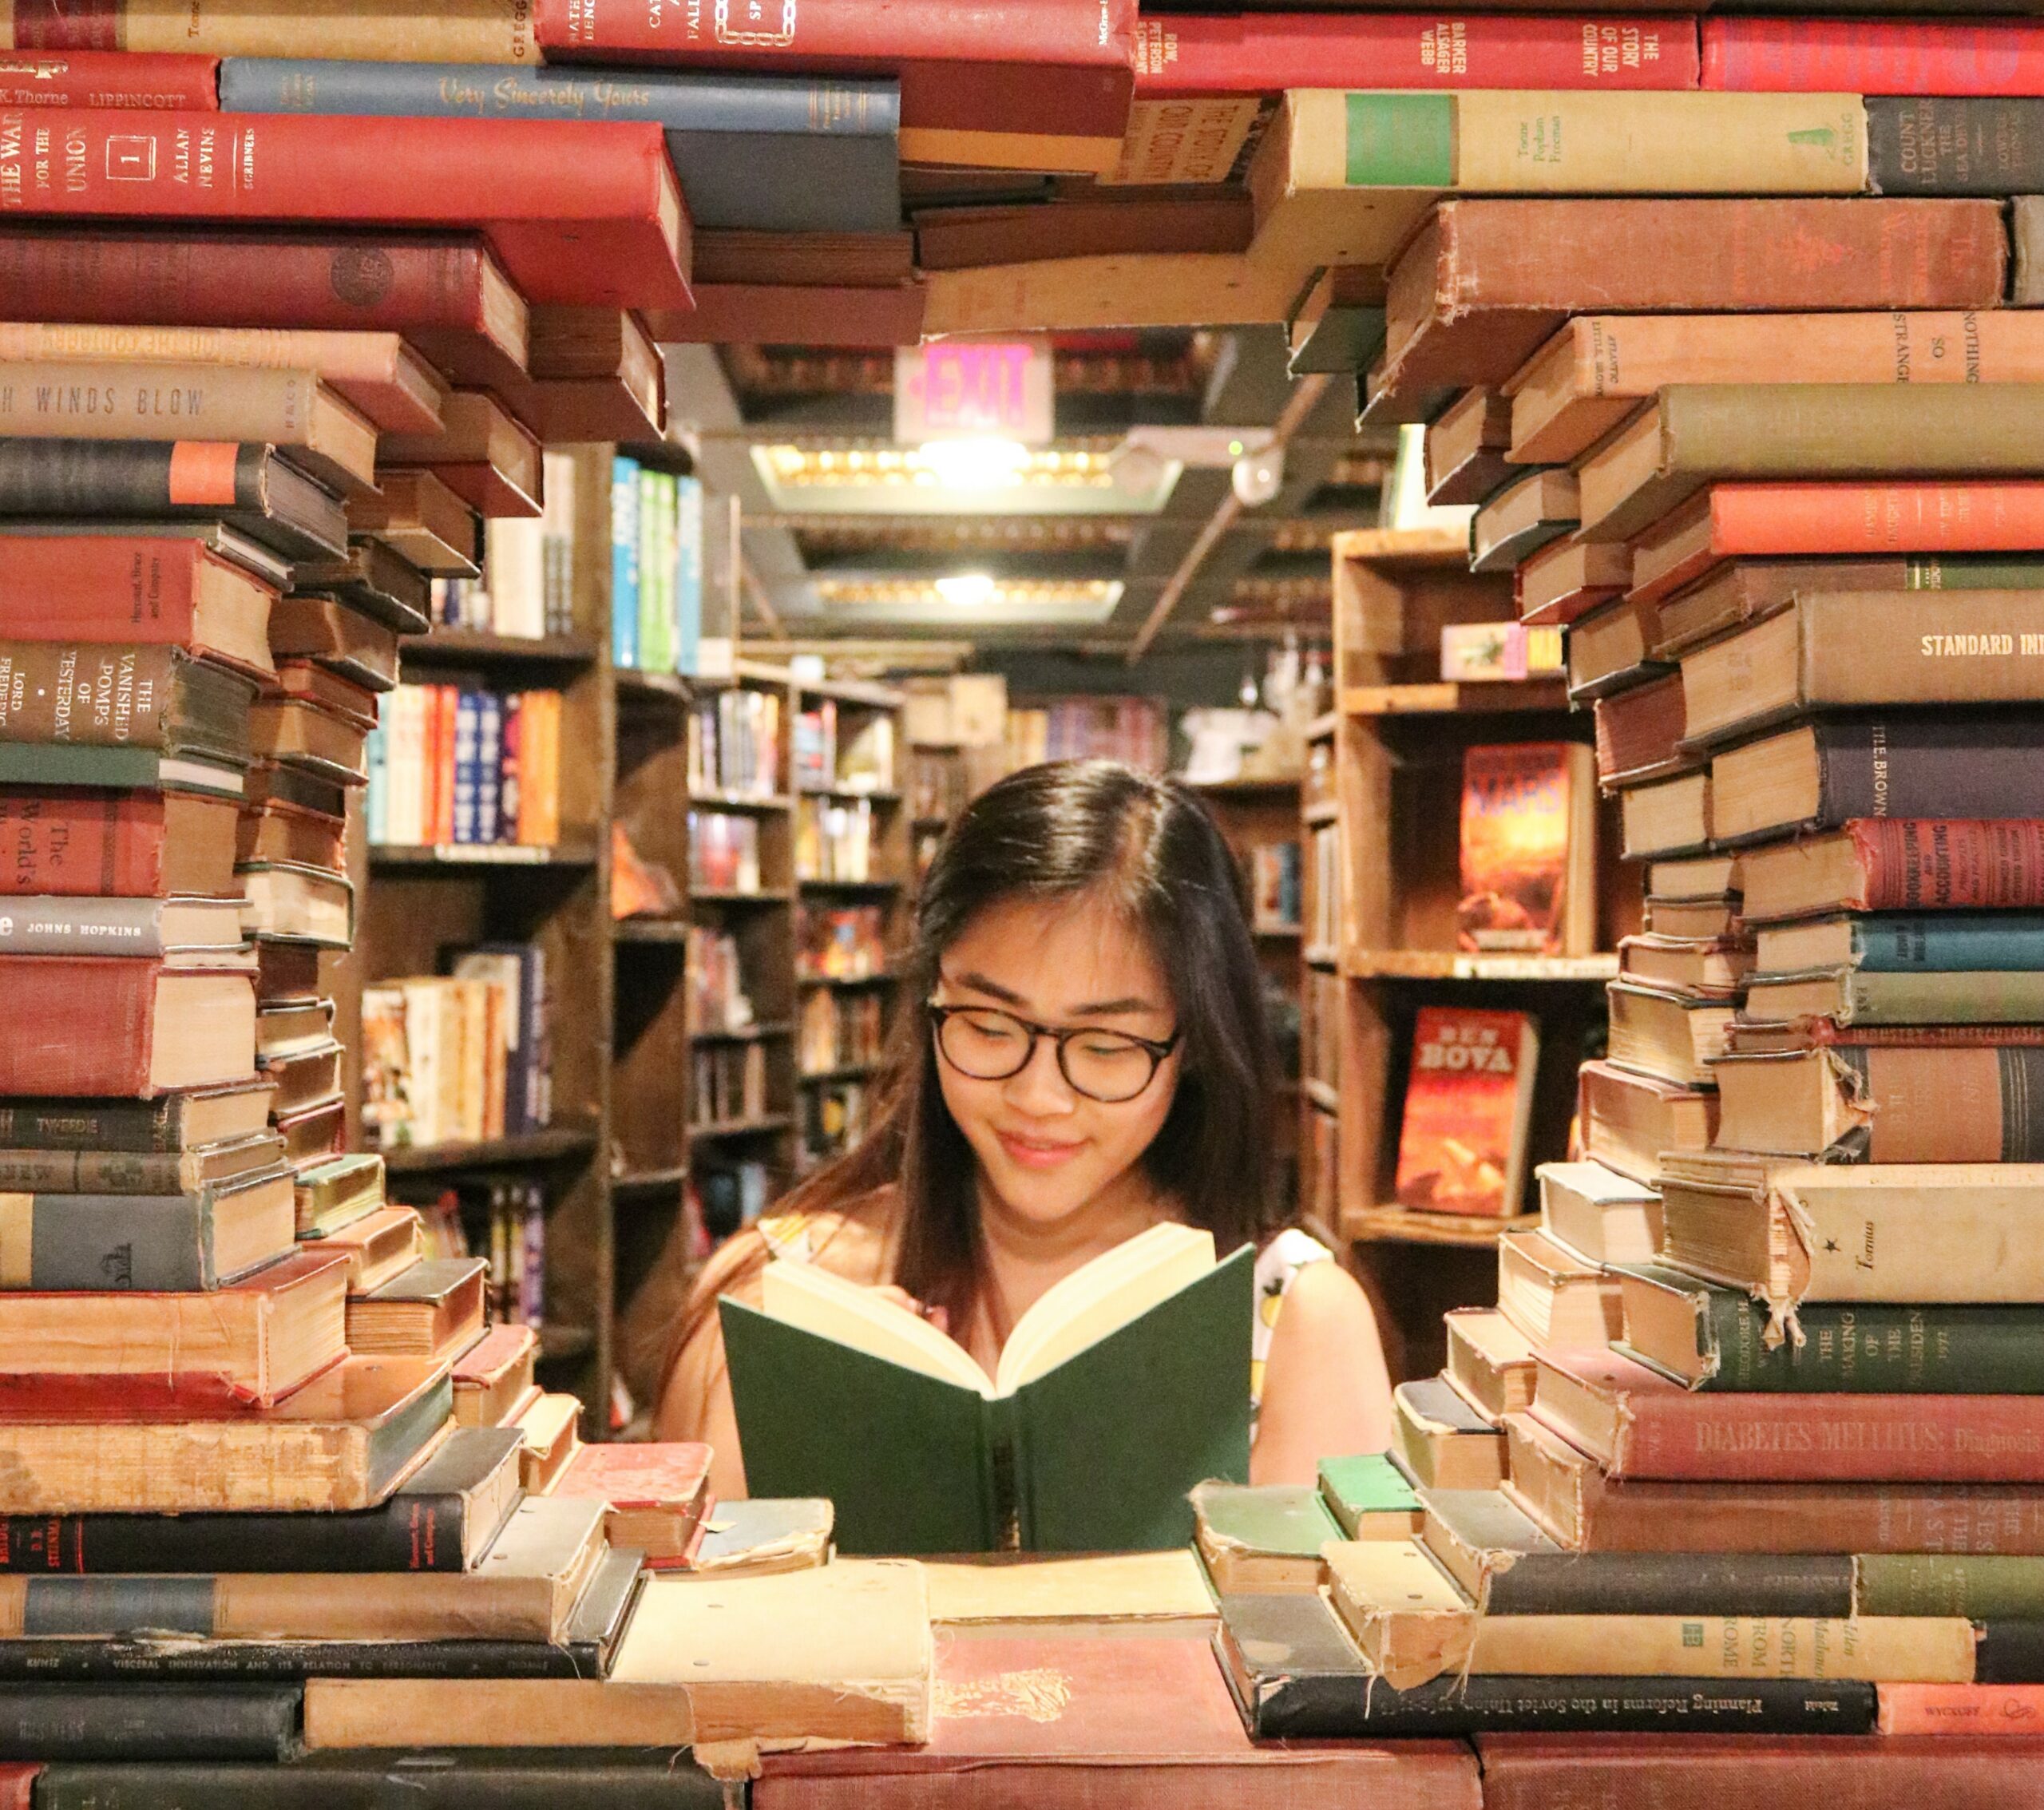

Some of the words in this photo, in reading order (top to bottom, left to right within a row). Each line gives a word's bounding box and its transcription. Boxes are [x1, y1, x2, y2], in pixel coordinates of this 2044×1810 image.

[1149, 21, 1163, 74] PETERSON
[1164, 33, 1178, 64] ROW,
[1420, 30, 1436, 65] WEBB
[1436, 22, 1451, 74] ALSAGER
[1451, 22, 1467, 74] BARKER
[1583, 23, 1598, 77] COUNTRY
[1601, 26, 1617, 45] OF
[1622, 27, 1639, 68] STORY
[1643, 34, 1660, 61] THE
[1602, 46, 1618, 73] OUR
[14, 88, 69, 105] Thorne
[89, 93, 187, 109] LIPPINCOTT
[439, 76, 485, 114] Very
[493, 75, 584, 117] Sincerely
[592, 77, 651, 117] Yours
[36, 128, 50, 155] THE
[65, 125, 88, 192] UNION
[173, 128, 190, 184] ALLAN
[199, 127, 215, 188] NEVINS
[1518, 121, 1529, 159] Tonne
[1841, 112, 1855, 166] GREGG
[1899, 111, 1916, 173] COUNT
[1919, 99, 1937, 184] LUCKNER
[1939, 124, 1951, 156] THE
[36, 160, 50, 189] FOR
[120, 155, 141, 164] 1
[242, 128, 256, 191] SCRIBNERS
[1956, 153, 1968, 183] SEA
[2, 162, 23, 206] THE
[1607, 335, 1618, 384] ATLANTIC
[1892, 313, 1910, 383] STRANGE
[1931, 337, 1945, 359] SO
[1963, 311, 1979, 384] NOTHING
[37, 386, 116, 414] WINDS
[137, 387, 204, 417] BLOW
[923, 343, 1035, 427] EXIT
[1920, 634, 2014, 656] STANDARD
[10, 671, 26, 711] LORD
[54, 650, 77, 742] YESTERDAY
[78, 682, 93, 705] OF
[93, 663, 114, 726] POMPS
[115, 652, 136, 742] VANISHED
[137, 679, 154, 714] THE
[1872, 760, 1888, 818] BROWN
[16, 800, 41, 886] World's
[49, 822, 70, 868] The
[1932, 824, 1951, 906] ACCOUNTING
[27, 922, 72, 935] JOHNS
[80, 924, 141, 937] HOPKINS
[1737, 1317, 1749, 1386] THEODORE
[1819, 1329, 1833, 1362] THE
[1840, 1312, 1856, 1379] MAKING
[1865, 1333, 1880, 1357] OF
[1886, 1327, 1901, 1362] THE
[1907, 1310, 1924, 1388] PRESIDEN
[1695, 1421, 1812, 1452] DIABETES
[1722, 1616, 1739, 1668] ROME
[26, 1658, 61, 1669] KUNTZ
[113, 1659, 160, 1670] VISCERAL
[168, 1660, 238, 1670] INNERVATION
[246, 1661, 269, 1670] AND
[277, 1661, 294, 1670] ITS
[302, 1661, 351, 1671] RELATION
[1464, 1697, 1515, 1716] Union
[1516, 1698, 1567, 1716] Soviet
[1570, 1697, 1597, 1715] the
[1601, 1698, 1619, 1715] in
[1622, 1698, 1689, 1715] Reforms
[1692, 1693, 1763, 1715] Planning
